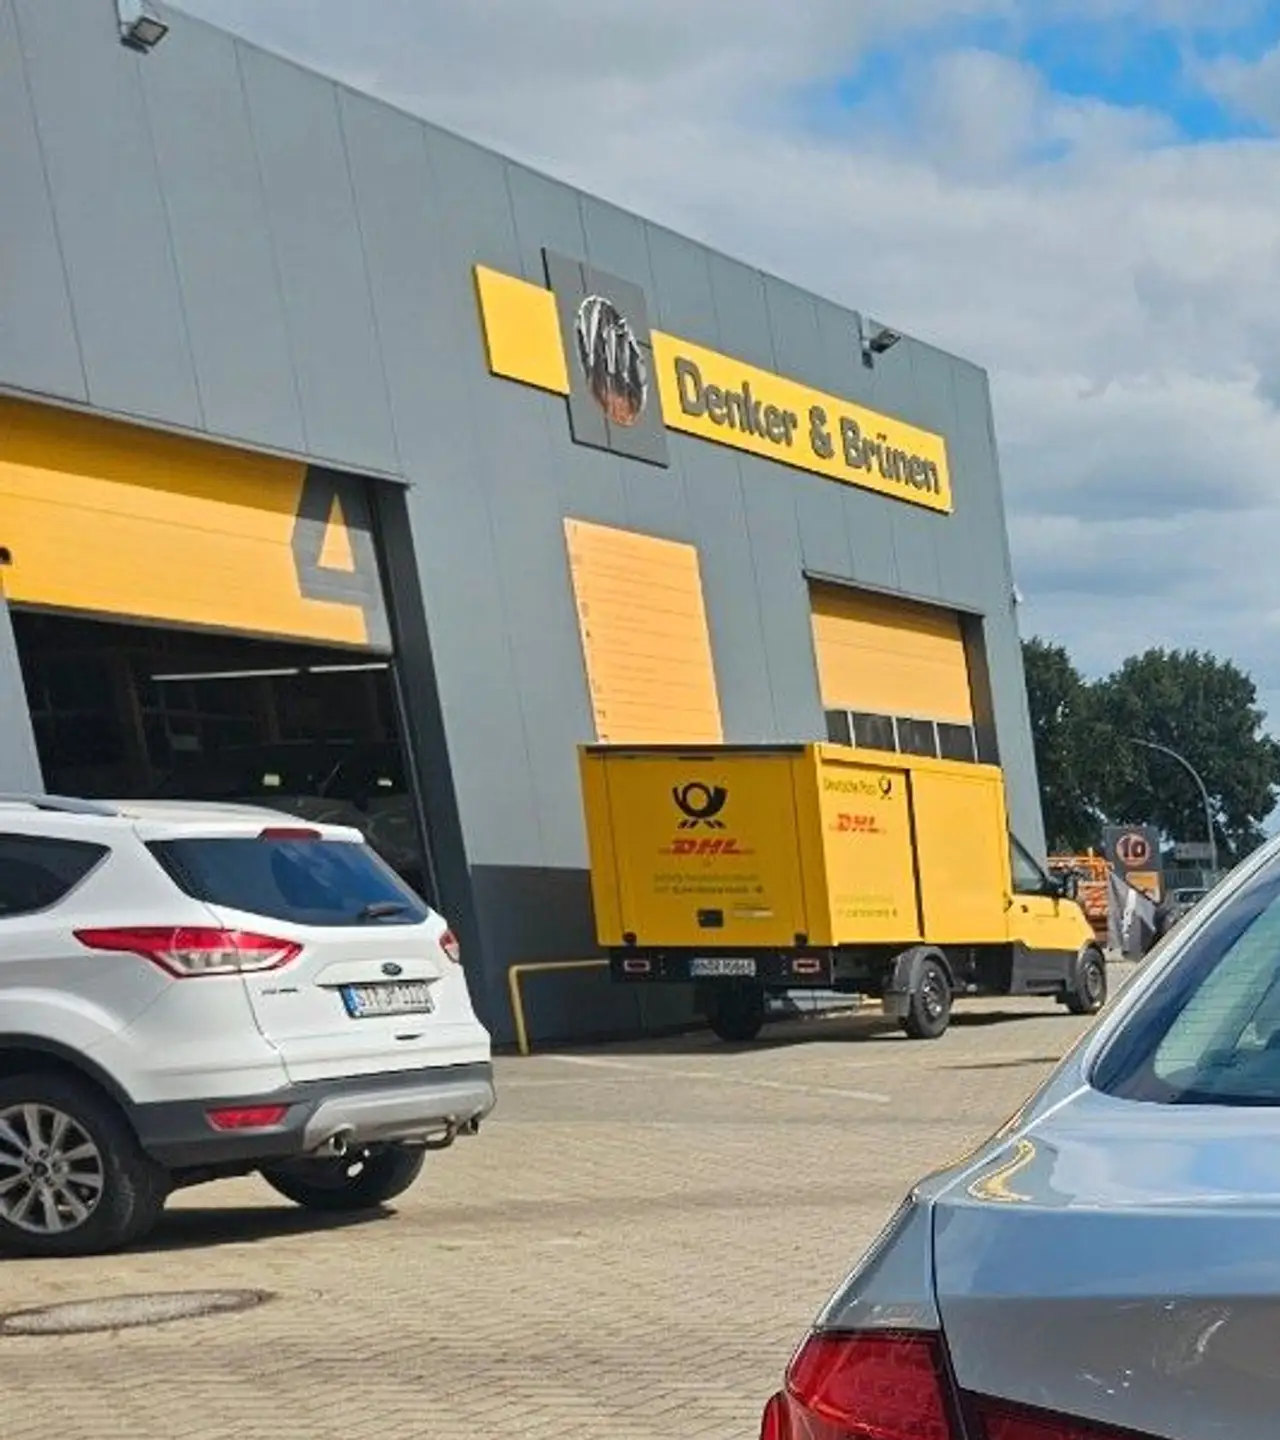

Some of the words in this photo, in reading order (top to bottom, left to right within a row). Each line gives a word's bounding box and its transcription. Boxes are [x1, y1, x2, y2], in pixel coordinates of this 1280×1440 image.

[674, 355, 799, 447] Denker
[808, 405, 836, 460] &
[840, 415, 941, 496] Brünen
[671, 838, 741, 855] DHL
